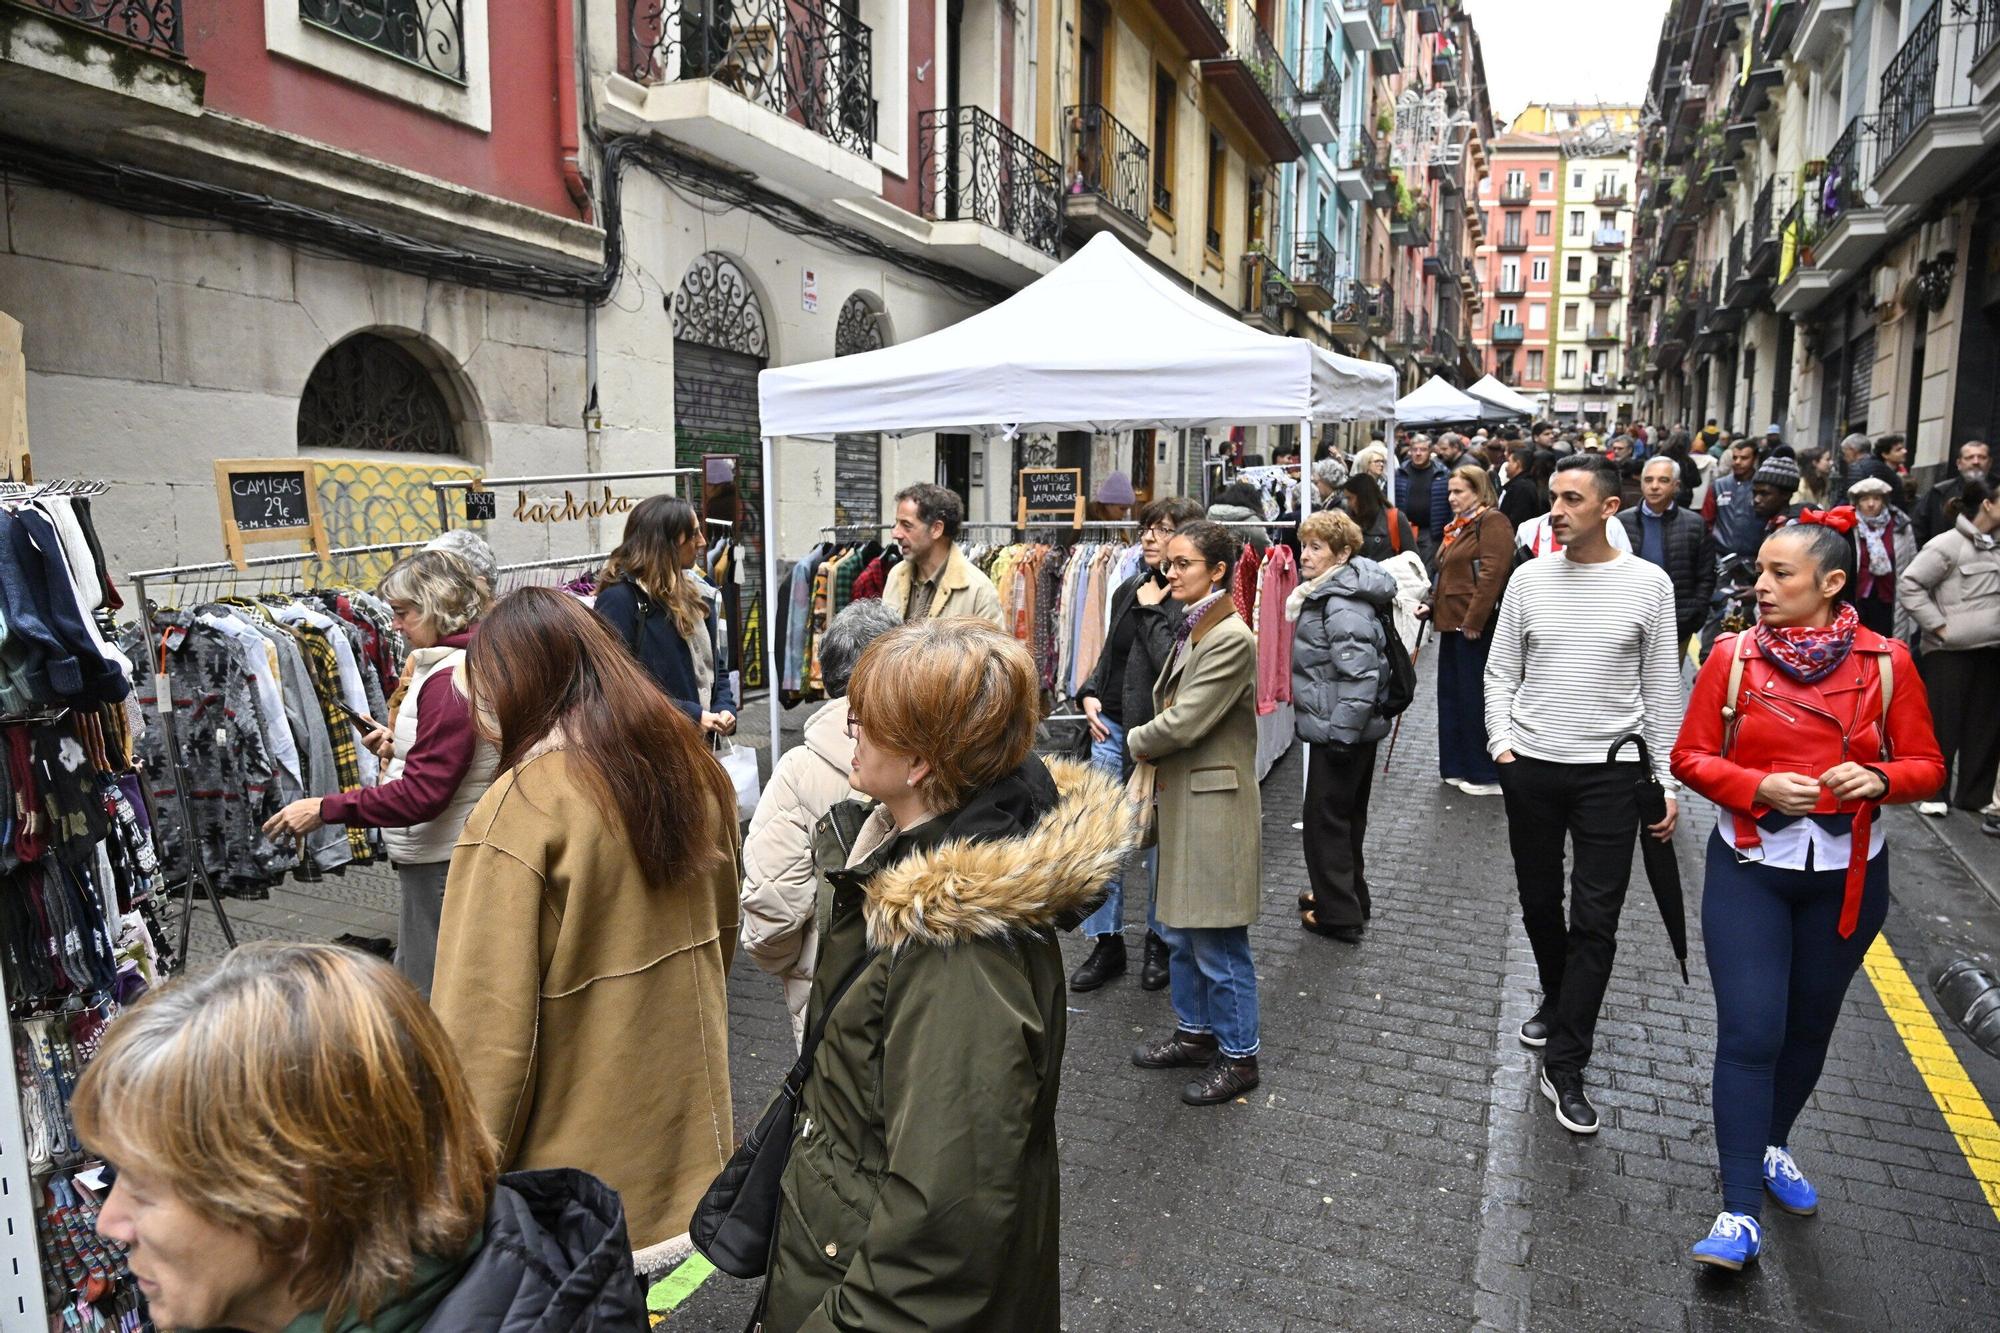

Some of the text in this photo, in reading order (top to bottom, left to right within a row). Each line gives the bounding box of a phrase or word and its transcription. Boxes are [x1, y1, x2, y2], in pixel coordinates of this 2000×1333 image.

[1030, 474, 1070, 483] CAMISAS
[232, 477, 301, 496] CAMISAS
[1032, 483, 1071, 492] VINTAGE
[1030, 493, 1077, 503] JAPONESAS
[264, 496, 290, 517] 29€
